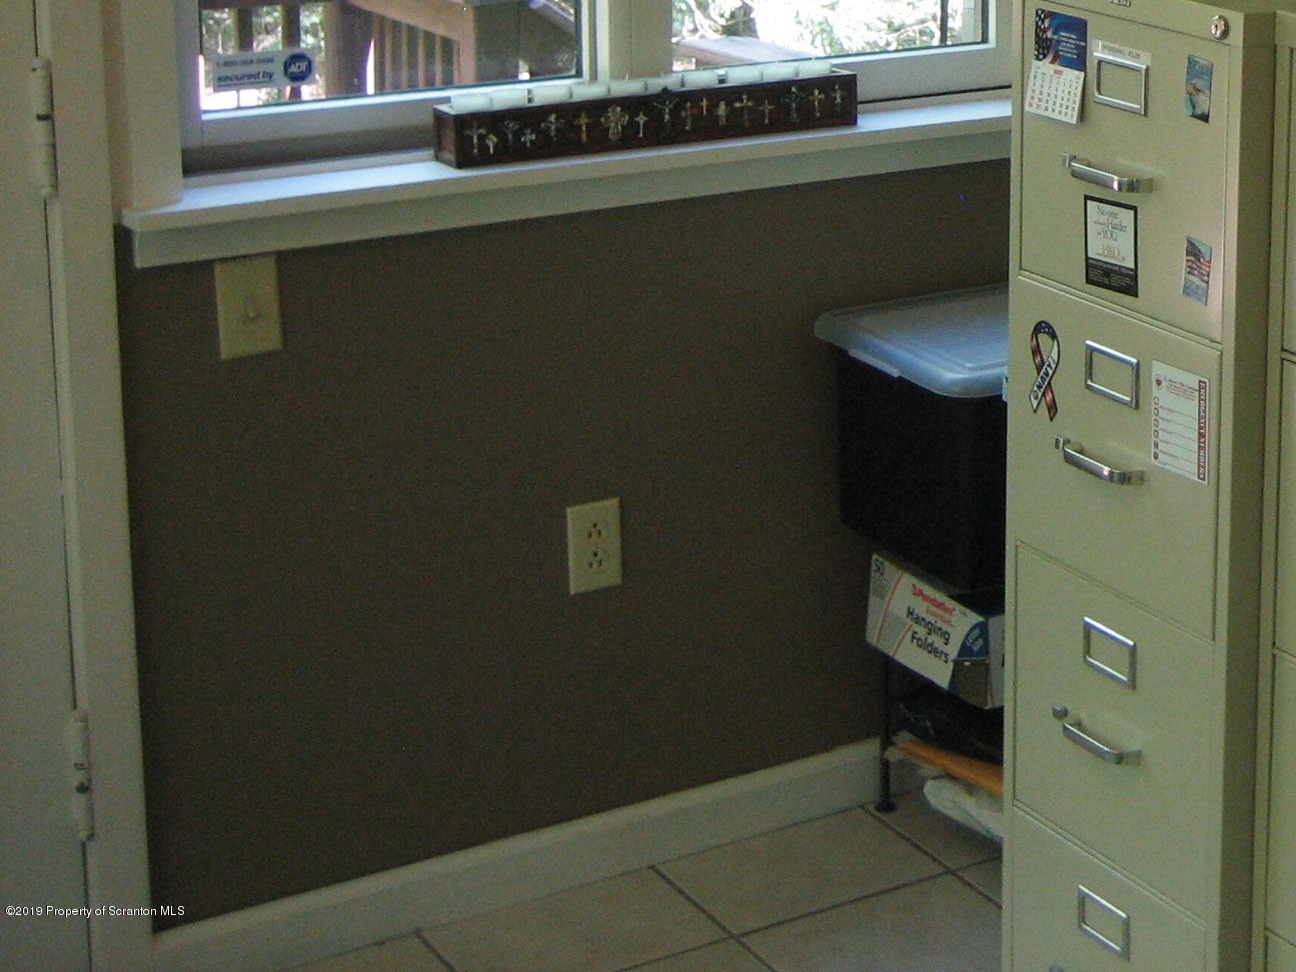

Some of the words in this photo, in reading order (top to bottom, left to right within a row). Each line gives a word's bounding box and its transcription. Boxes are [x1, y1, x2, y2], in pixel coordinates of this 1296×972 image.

[217, 70, 260, 83] secured
[261, 70, 275, 82] by
[289, 62, 307, 73] ADT
[1035, 360, 1054, 394] NAVY
[906, 605, 951, 646] Hanging
[910, 630, 950, 664] Folders
